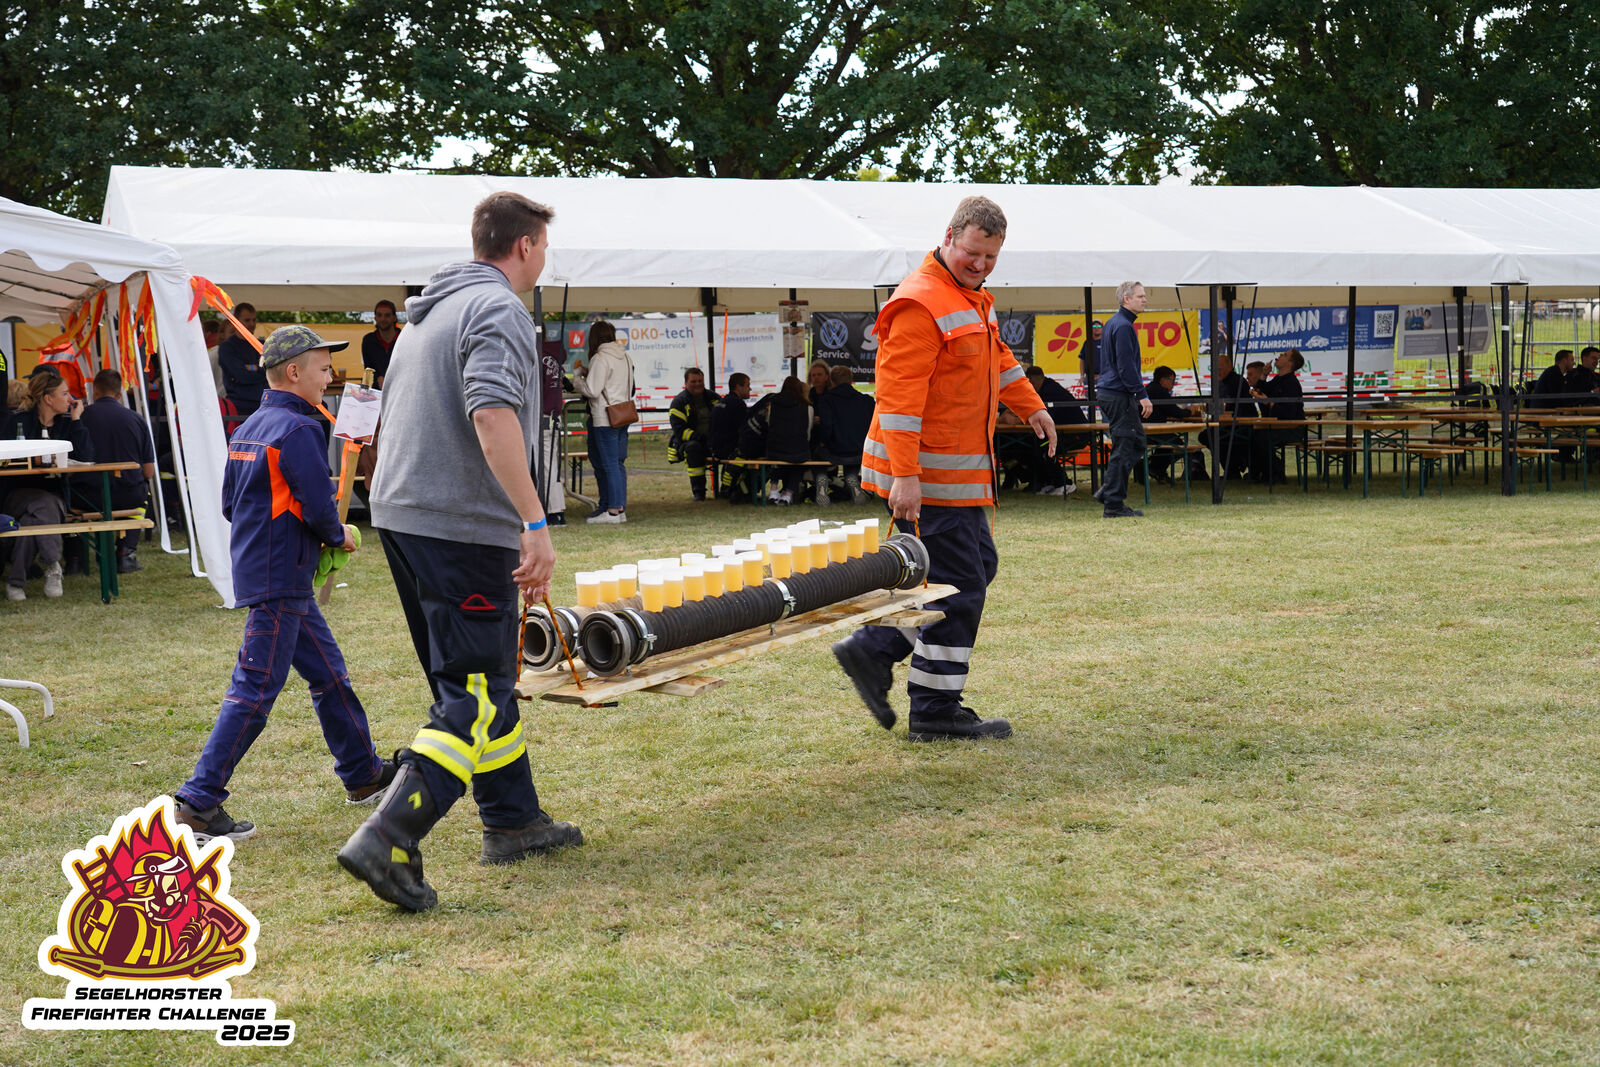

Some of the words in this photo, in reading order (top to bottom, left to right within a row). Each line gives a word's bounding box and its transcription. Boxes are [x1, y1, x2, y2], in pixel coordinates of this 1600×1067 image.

[1235, 309, 1321, 340] BEHMANN
[726, 335, 774, 343] bwassertechnik
[1133, 321, 1181, 348] TTO
[632, 341, 687, 351] Umweltservice
[1260, 338, 1303, 349] FAHRSCHULE
[817, 350, 850, 359] Service
